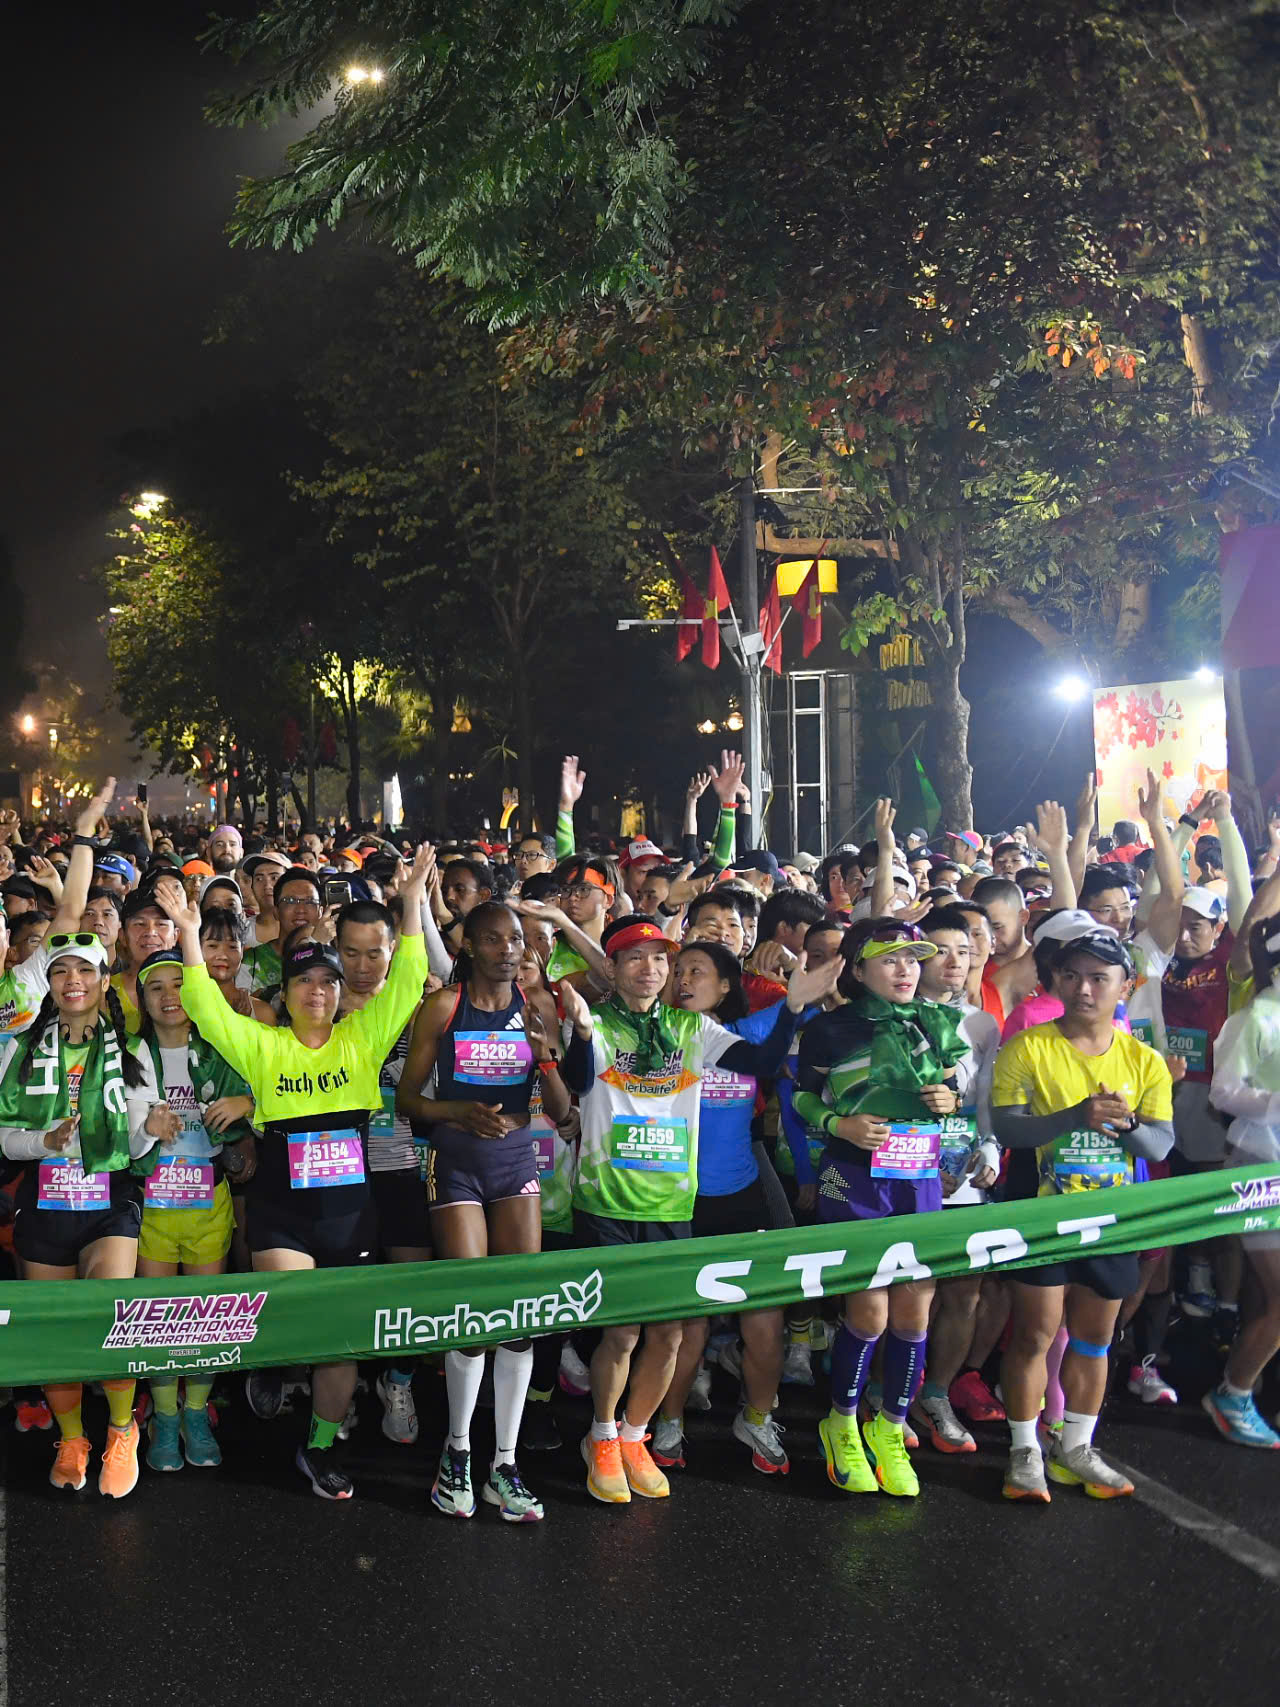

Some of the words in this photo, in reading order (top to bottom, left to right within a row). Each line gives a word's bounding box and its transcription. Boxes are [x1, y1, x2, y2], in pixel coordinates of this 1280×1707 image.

[471, 1043, 517, 1060] 25262
[627, 1126, 675, 1144] 21559
[303, 1141, 349, 1161] 25154
[888, 1136, 931, 1153] 25289
[159, 1167, 202, 1184] 25349
[115, 1292, 268, 1324] VIETNAM
[111, 1318, 257, 1337] INTERNATIONAL
[104, 1336, 141, 1347] HALF
[143, 1333, 222, 1346] MARATHON
[222, 1330, 256, 1342] 2025
